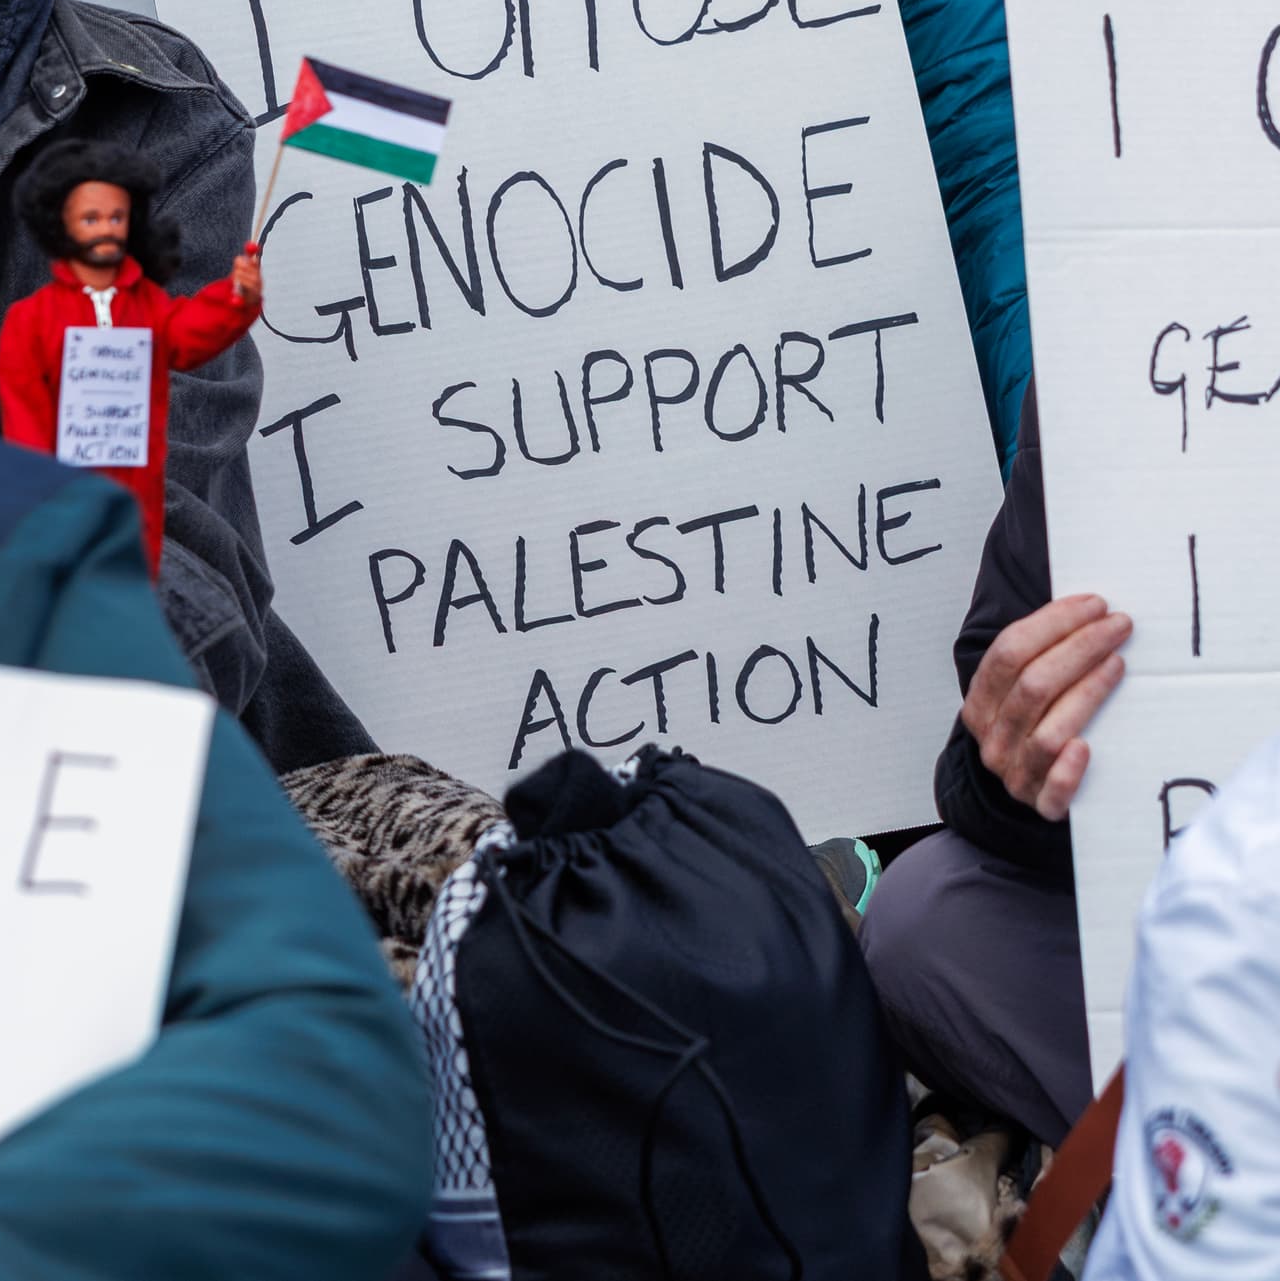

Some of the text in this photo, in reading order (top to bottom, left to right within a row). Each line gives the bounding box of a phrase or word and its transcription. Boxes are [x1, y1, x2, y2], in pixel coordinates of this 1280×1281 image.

[1103, 13, 1121, 159] I
[257, 115, 874, 362] GENOCIDE
[75, 441, 140, 460] ACTION
[259, 312, 922, 546] I SUPPORT
[368, 477, 944, 655] PALESTINE
[1187, 533, 1201, 658] I
[509, 613, 880, 771] ACTION
